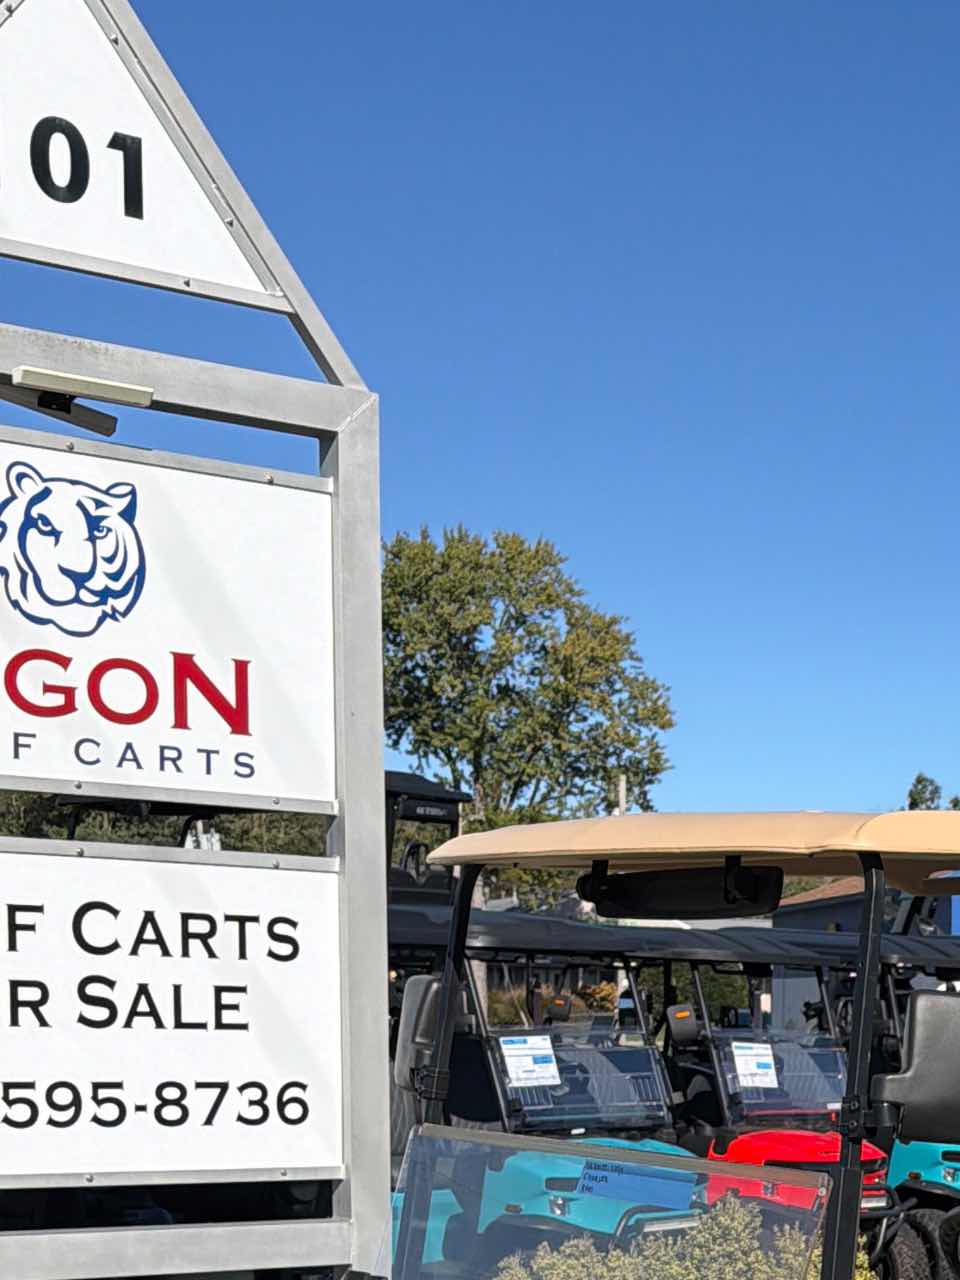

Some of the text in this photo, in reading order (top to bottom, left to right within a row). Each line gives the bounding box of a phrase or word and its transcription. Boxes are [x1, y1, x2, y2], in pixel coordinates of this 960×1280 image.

[29, 116, 144, 220] 01
[3, 648, 252, 736] GON
[74, 737, 256, 779] CARTS
[71, 901, 300, 962] CARTS
[77, 974, 249, 1031] SALE
[0, 1080, 310, 1129] 595-8736
